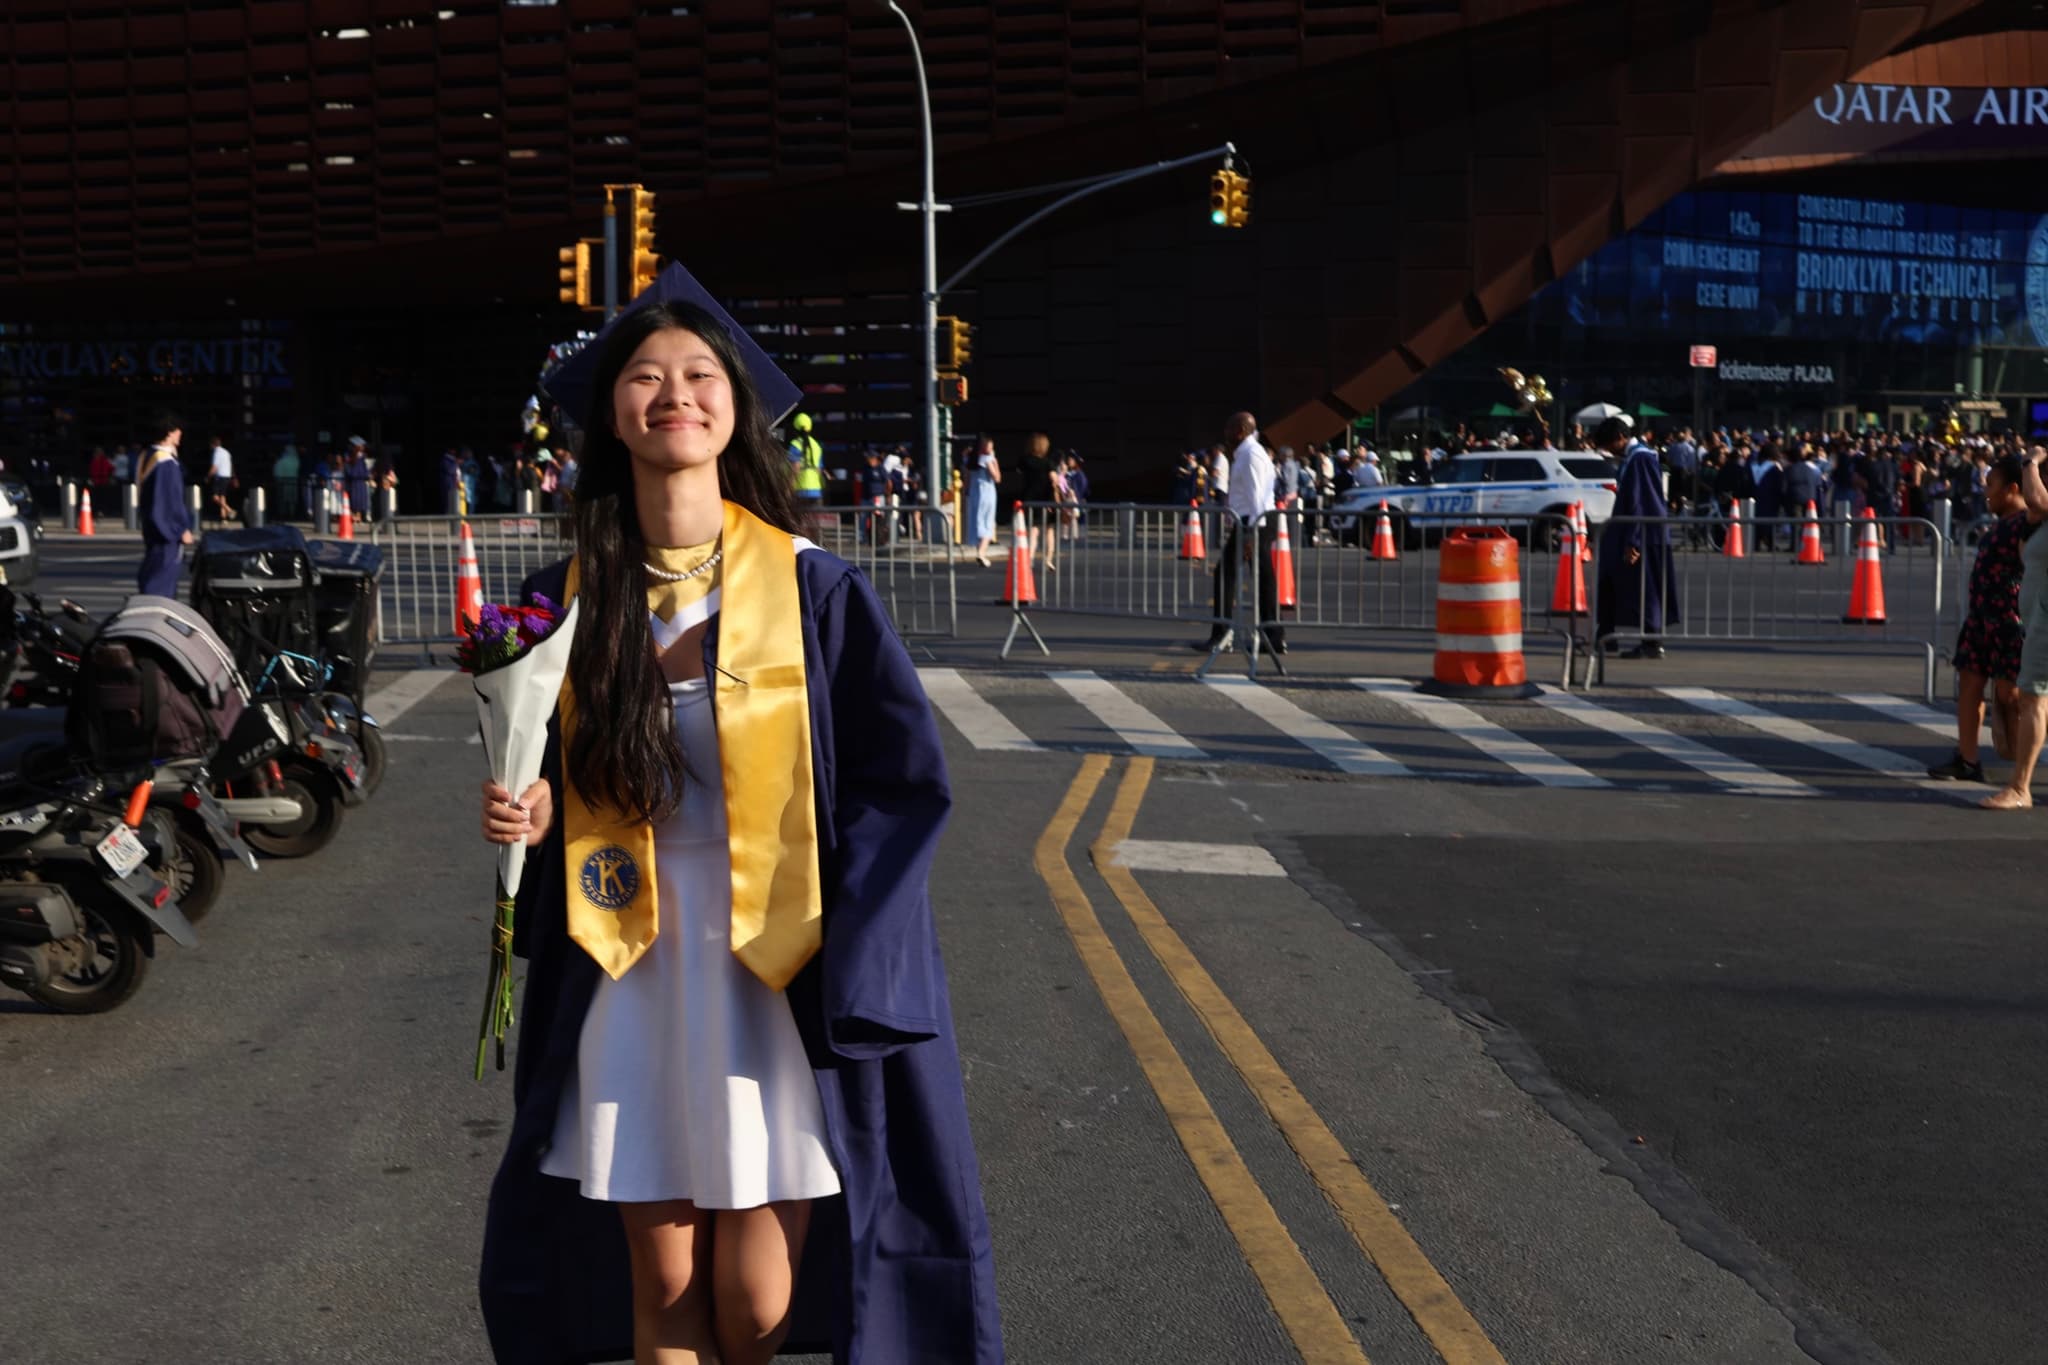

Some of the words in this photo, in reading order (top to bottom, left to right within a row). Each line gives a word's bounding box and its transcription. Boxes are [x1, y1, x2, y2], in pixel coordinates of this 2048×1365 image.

[1814, 83, 1953, 124] QATAR
[1973, 87, 2048, 125] AIR
[1797, 193, 1905, 228] CONGRATULATIONS
[1663, 238, 1760, 274] COMMENCEMENT
[1798, 221, 1813, 247] TO
[1918, 231, 1956, 258] CLASS
[1970, 235, 2001, 261] 2024
[1797, 250, 1893, 295] BROOKLYN
[1899, 260, 1999, 301] TECHNICAL
[1696, 281, 1759, 311] CEREMONY
[147, 339, 287, 376] CENTER
[1719, 358, 1791, 382] ticketmaster
[1794, 364, 1834, 384] PLAZA
[1424, 495, 1473, 513] NYPD
[237, 738, 278, 765] UFO
